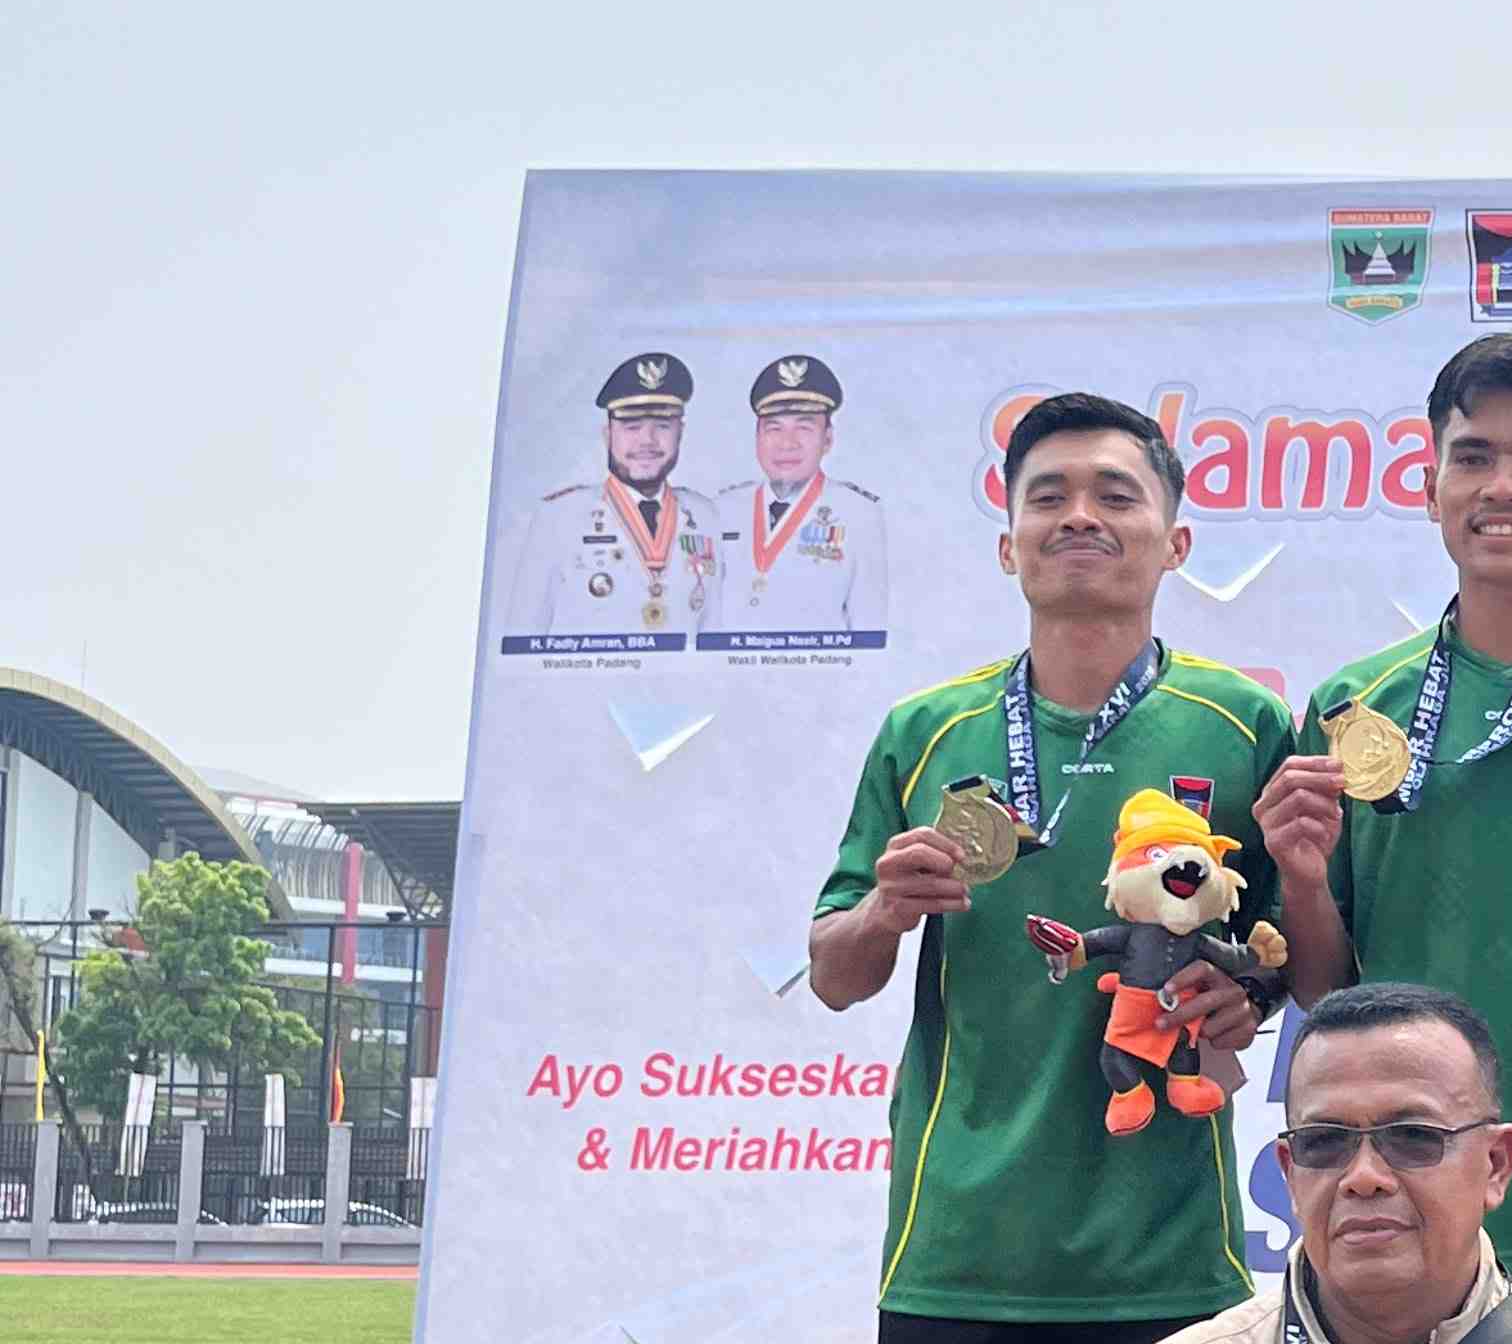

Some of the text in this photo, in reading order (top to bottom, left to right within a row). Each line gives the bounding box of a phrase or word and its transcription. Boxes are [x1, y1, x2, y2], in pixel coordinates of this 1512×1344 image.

[596, 656, 642, 670] Padang
[760, 654, 810, 666] Walikota
[813, 653, 853, 667] Padang
[1414, 649, 1445, 732] HEBAT
[1004, 694, 1026, 769] HEBAT
[527, 1051, 895, 1109] Ayo Sukseska
[576, 1125, 893, 1173] & Meriahkan
